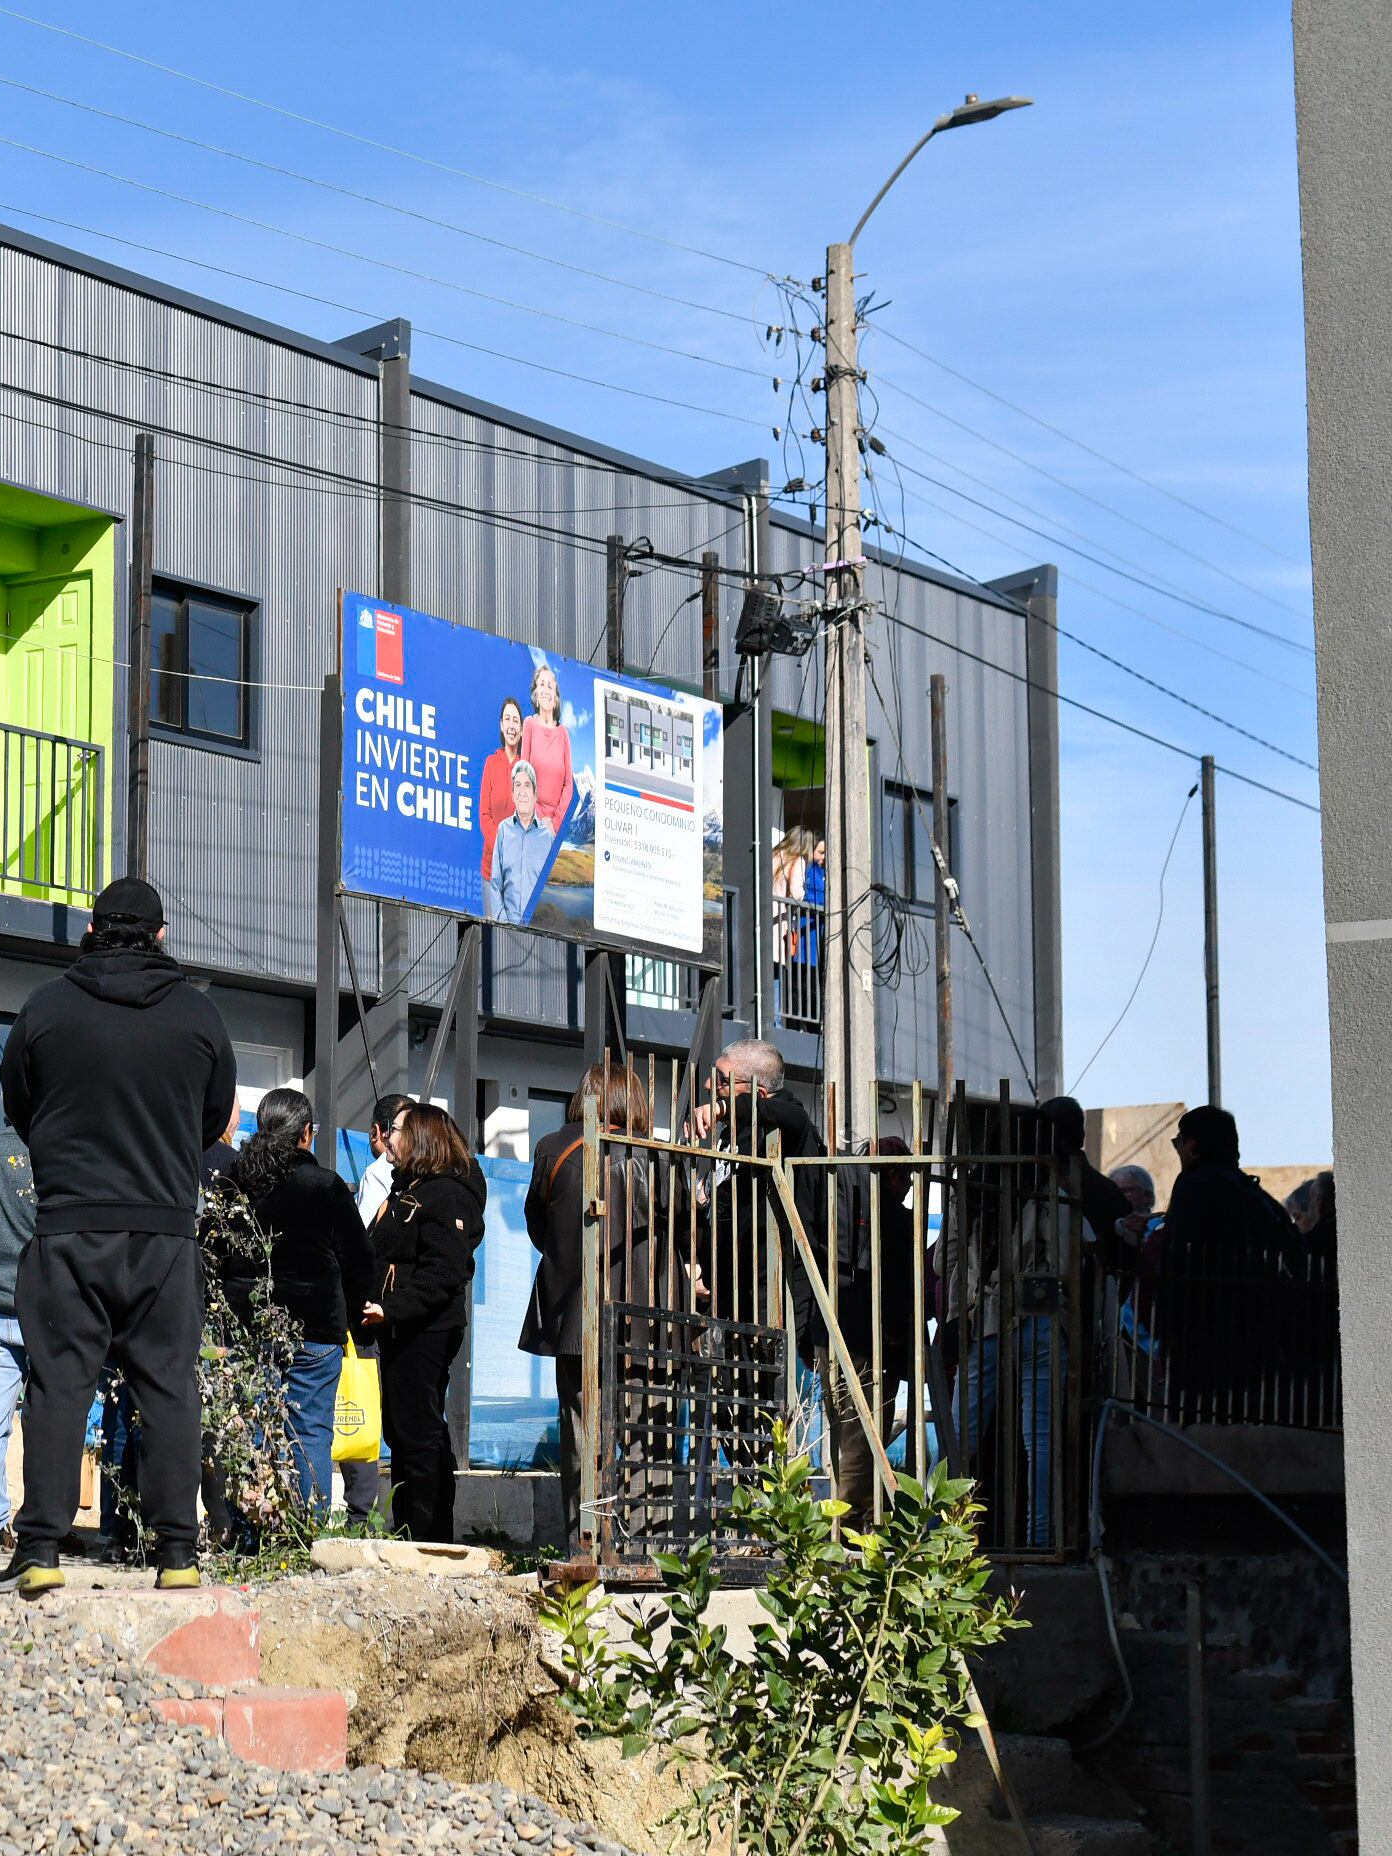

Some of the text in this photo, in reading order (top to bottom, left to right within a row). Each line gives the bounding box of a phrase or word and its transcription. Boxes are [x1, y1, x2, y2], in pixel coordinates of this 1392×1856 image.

[355, 687, 436, 740] CHILE
[356, 729, 470, 790] INVIERTE
[356, 771, 473, 831] EN CHILE
[604, 817, 633, 835] OLIVAR
[644, 808, 696, 833] CONDOMINIO
